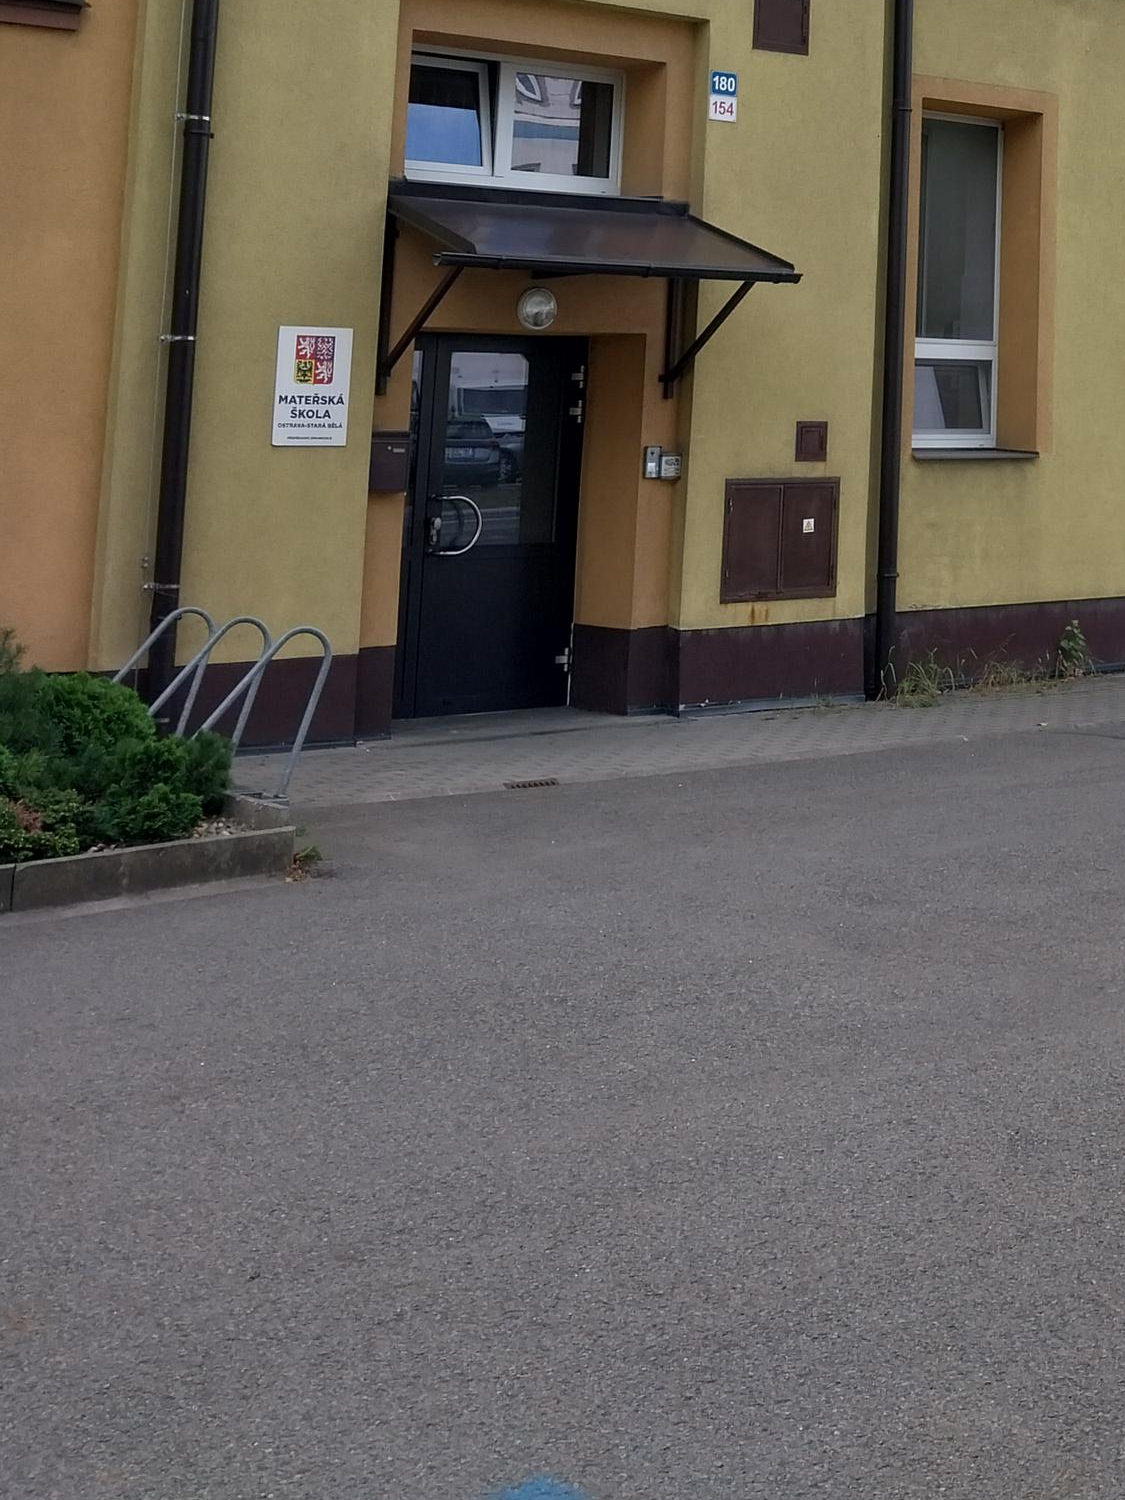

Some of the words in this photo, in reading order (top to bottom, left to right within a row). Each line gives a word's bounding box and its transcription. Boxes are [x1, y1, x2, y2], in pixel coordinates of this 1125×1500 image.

[713, 75, 735, 92] 180
[712, 100, 734, 116] 154
[278, 393, 344, 405] MATEŘSKÁ
[290, 406, 331, 419] ŠKOLA
